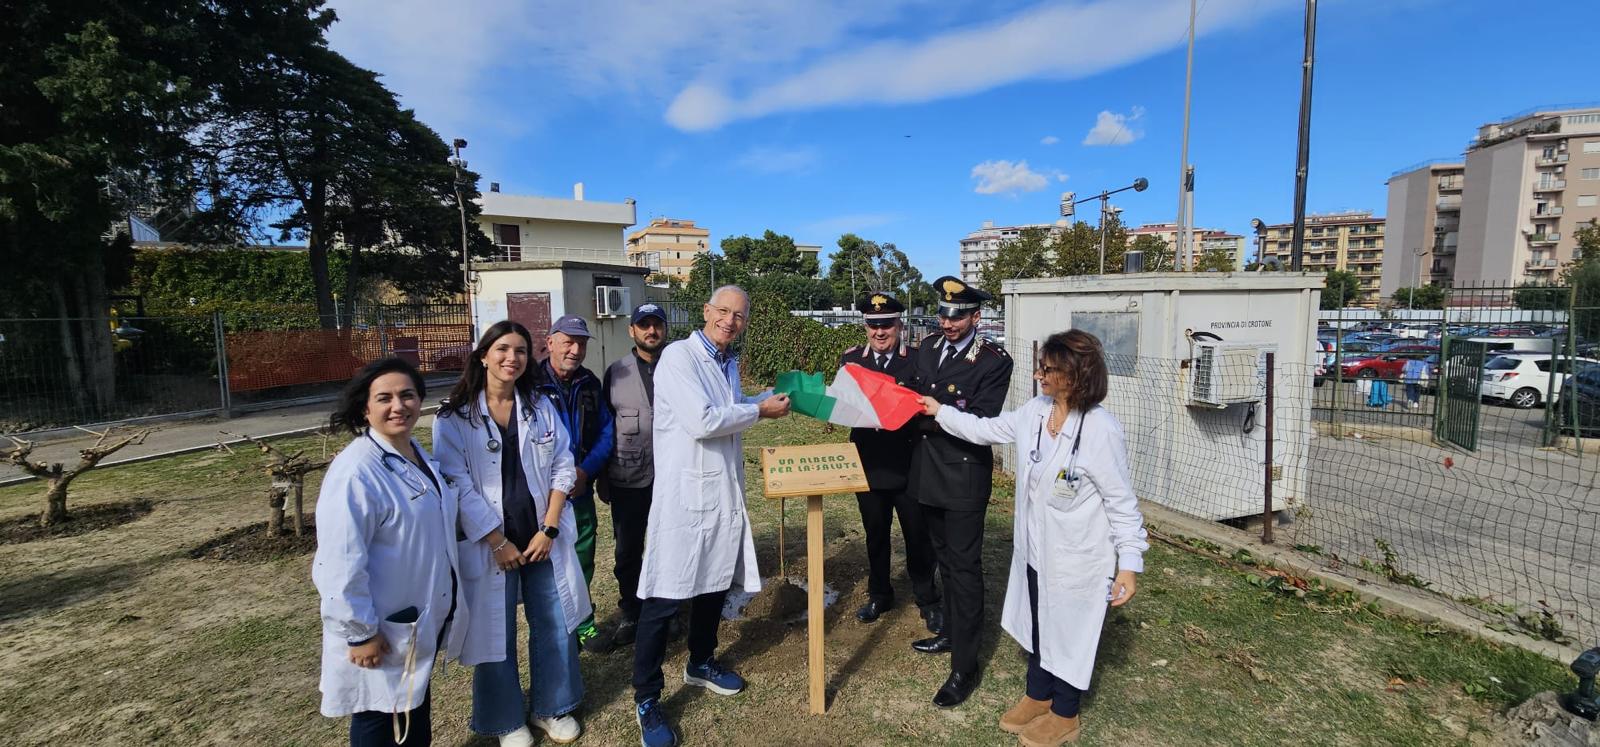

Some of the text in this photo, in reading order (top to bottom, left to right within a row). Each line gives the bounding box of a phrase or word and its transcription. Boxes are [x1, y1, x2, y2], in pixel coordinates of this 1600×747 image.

[1210, 321, 1240, 329] PROVINCIA
[1248, 320, 1272, 328] CROTONE
[799, 455, 846, 463] ALBERO
[769, 462, 858, 474] PER LA SALUTE
